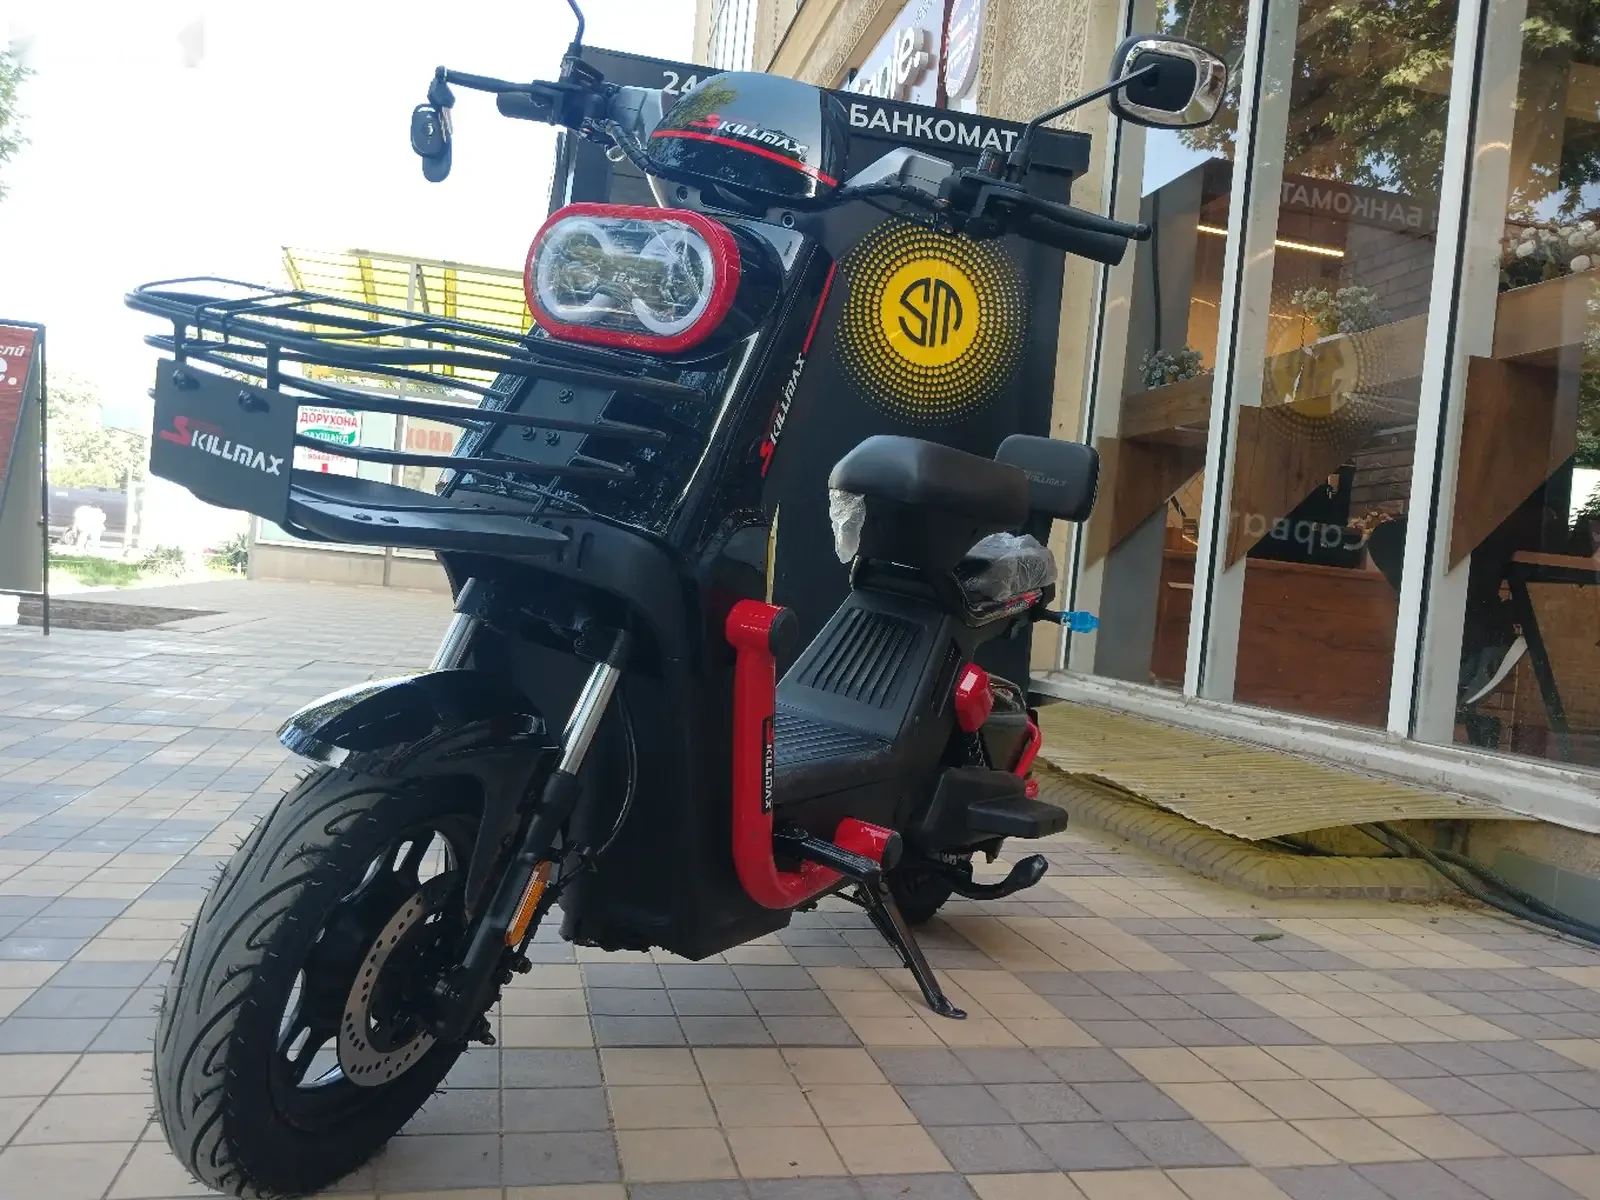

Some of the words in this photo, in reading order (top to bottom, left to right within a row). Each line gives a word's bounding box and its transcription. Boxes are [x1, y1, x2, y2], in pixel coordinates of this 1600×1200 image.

[690, 114, 809, 154] SKILLMAX
[850, 103, 1018, 153] БАНКОМАТ
[300, 412, 358, 428] ДОРУХОНА
[760, 352, 806, 478] SKILLMAX
[160, 415, 284, 476] SKILLMAX
